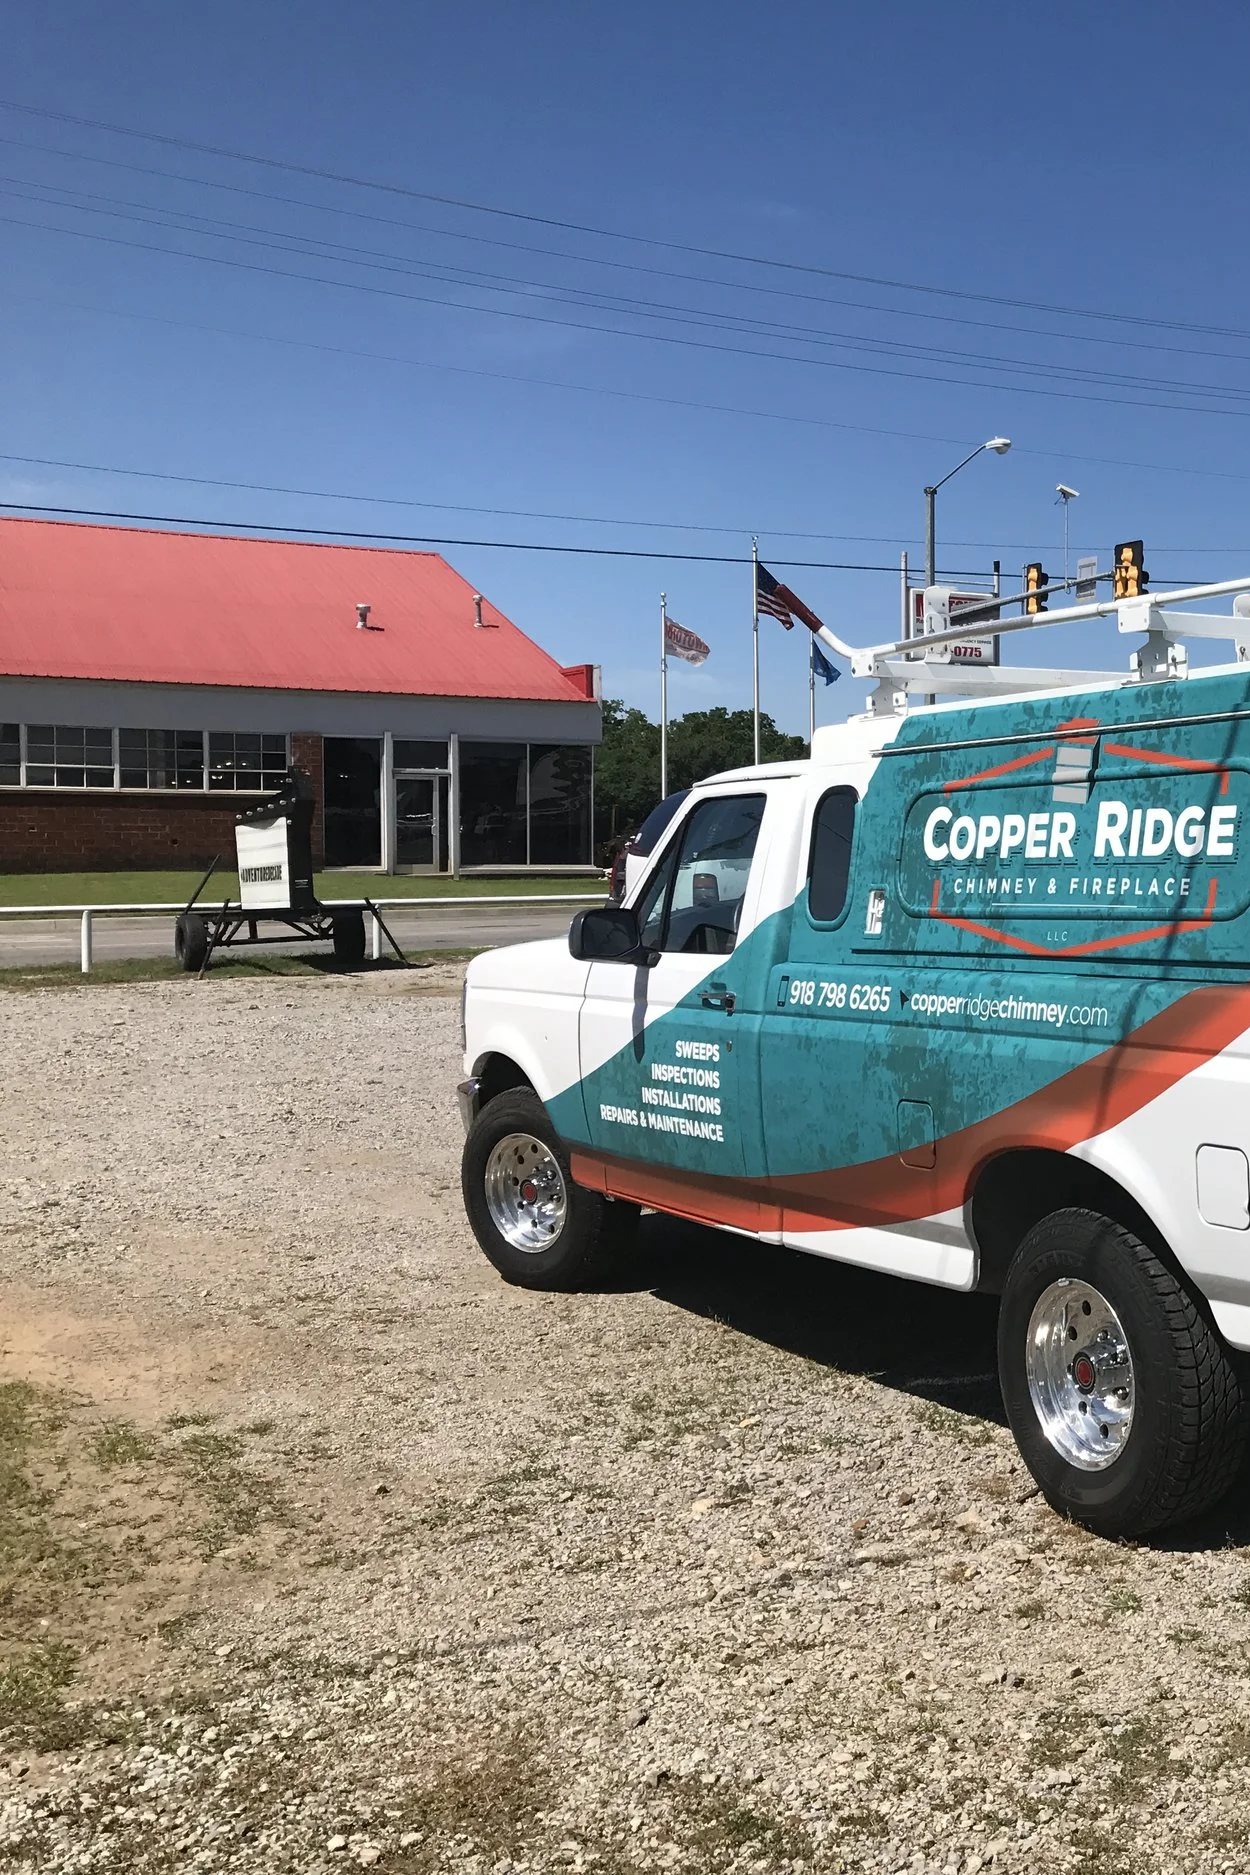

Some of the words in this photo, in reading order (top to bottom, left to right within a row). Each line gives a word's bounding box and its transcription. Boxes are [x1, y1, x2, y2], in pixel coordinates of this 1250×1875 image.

[923, 805, 1077, 861] COPPER
[1093, 800, 1238, 858] RIDGE
[954, 877, 1037, 895] CHIMNEY
[1047, 879, 1058, 895] &
[1069, 877, 1191, 896] FIREPLACE
[1047, 930, 1068, 942] LLC
[789, 980, 815, 1005] 918
[818, 982, 847, 1008] 798
[849, 984, 892, 1012] 6265
[910, 990, 1109, 1028] copperridgechimney.com
[675, 1040, 720, 1062] SWEEPS
[651, 1063, 720, 1089] INSPECTIONS
[641, 1087, 721, 1115] INSTALLATIONS
[600, 1104, 638, 1126] REPAIRS
[639, 1111, 648, 1127] &
[648, 1112, 724, 1142] MAINTENANCE
